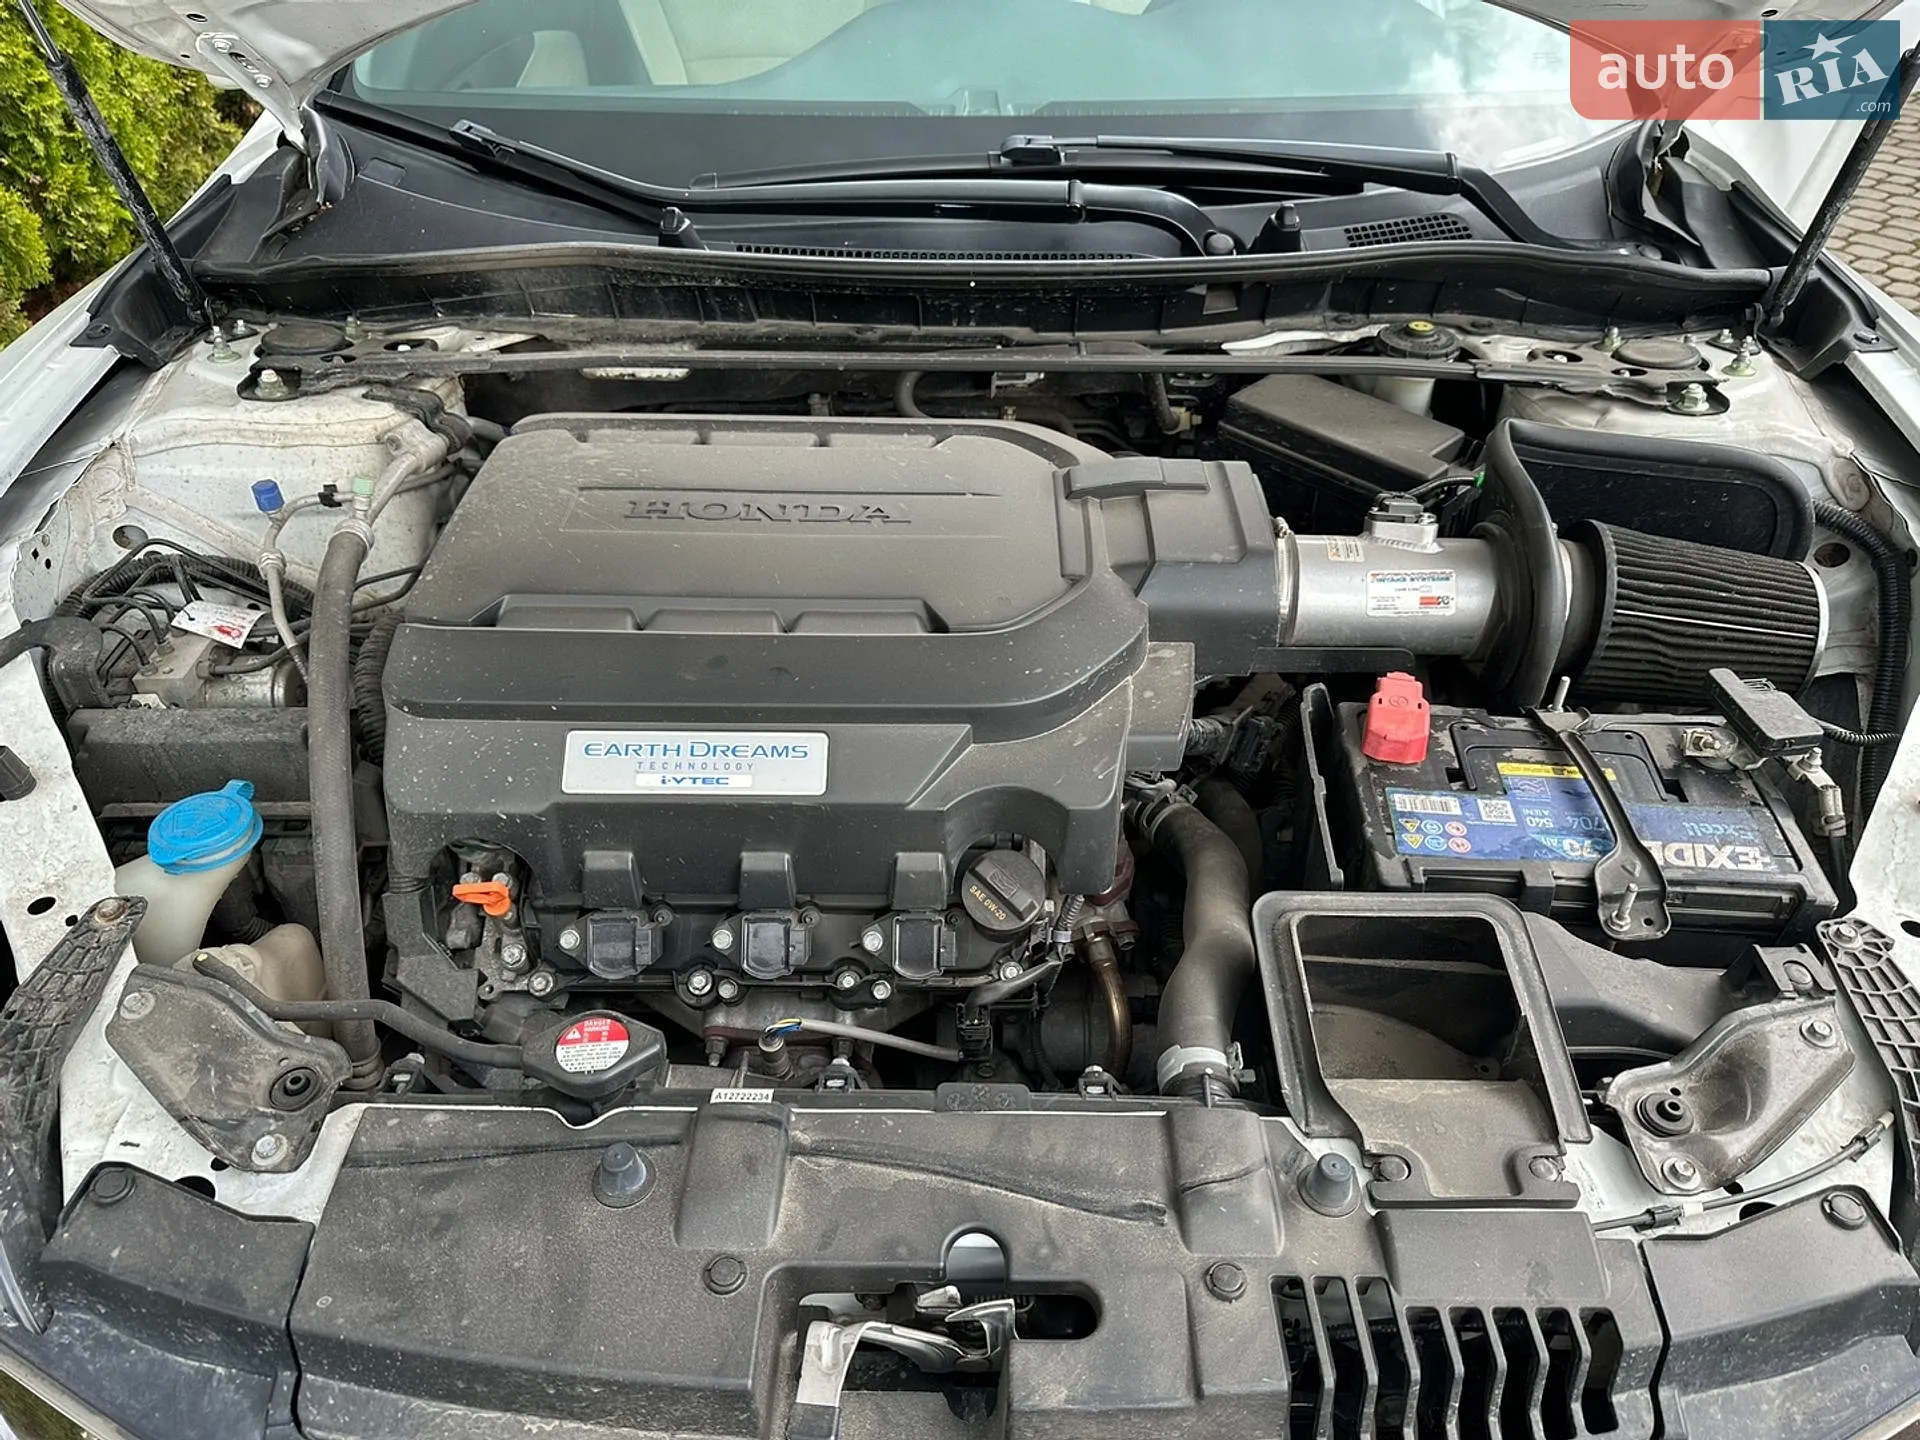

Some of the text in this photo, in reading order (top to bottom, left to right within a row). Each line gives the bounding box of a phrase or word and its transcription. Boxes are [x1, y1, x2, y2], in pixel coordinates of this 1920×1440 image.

[624, 500, 911, 524] HONDA
[584, 741, 809, 759] EARTH DREAMS
[637, 761, 755, 771] TECHNOLOGY
[1525, 816, 1554, 829] 540
[1682, 821, 1758, 841] Excell
[969, 885, 1007, 920] SAE 0W-20
